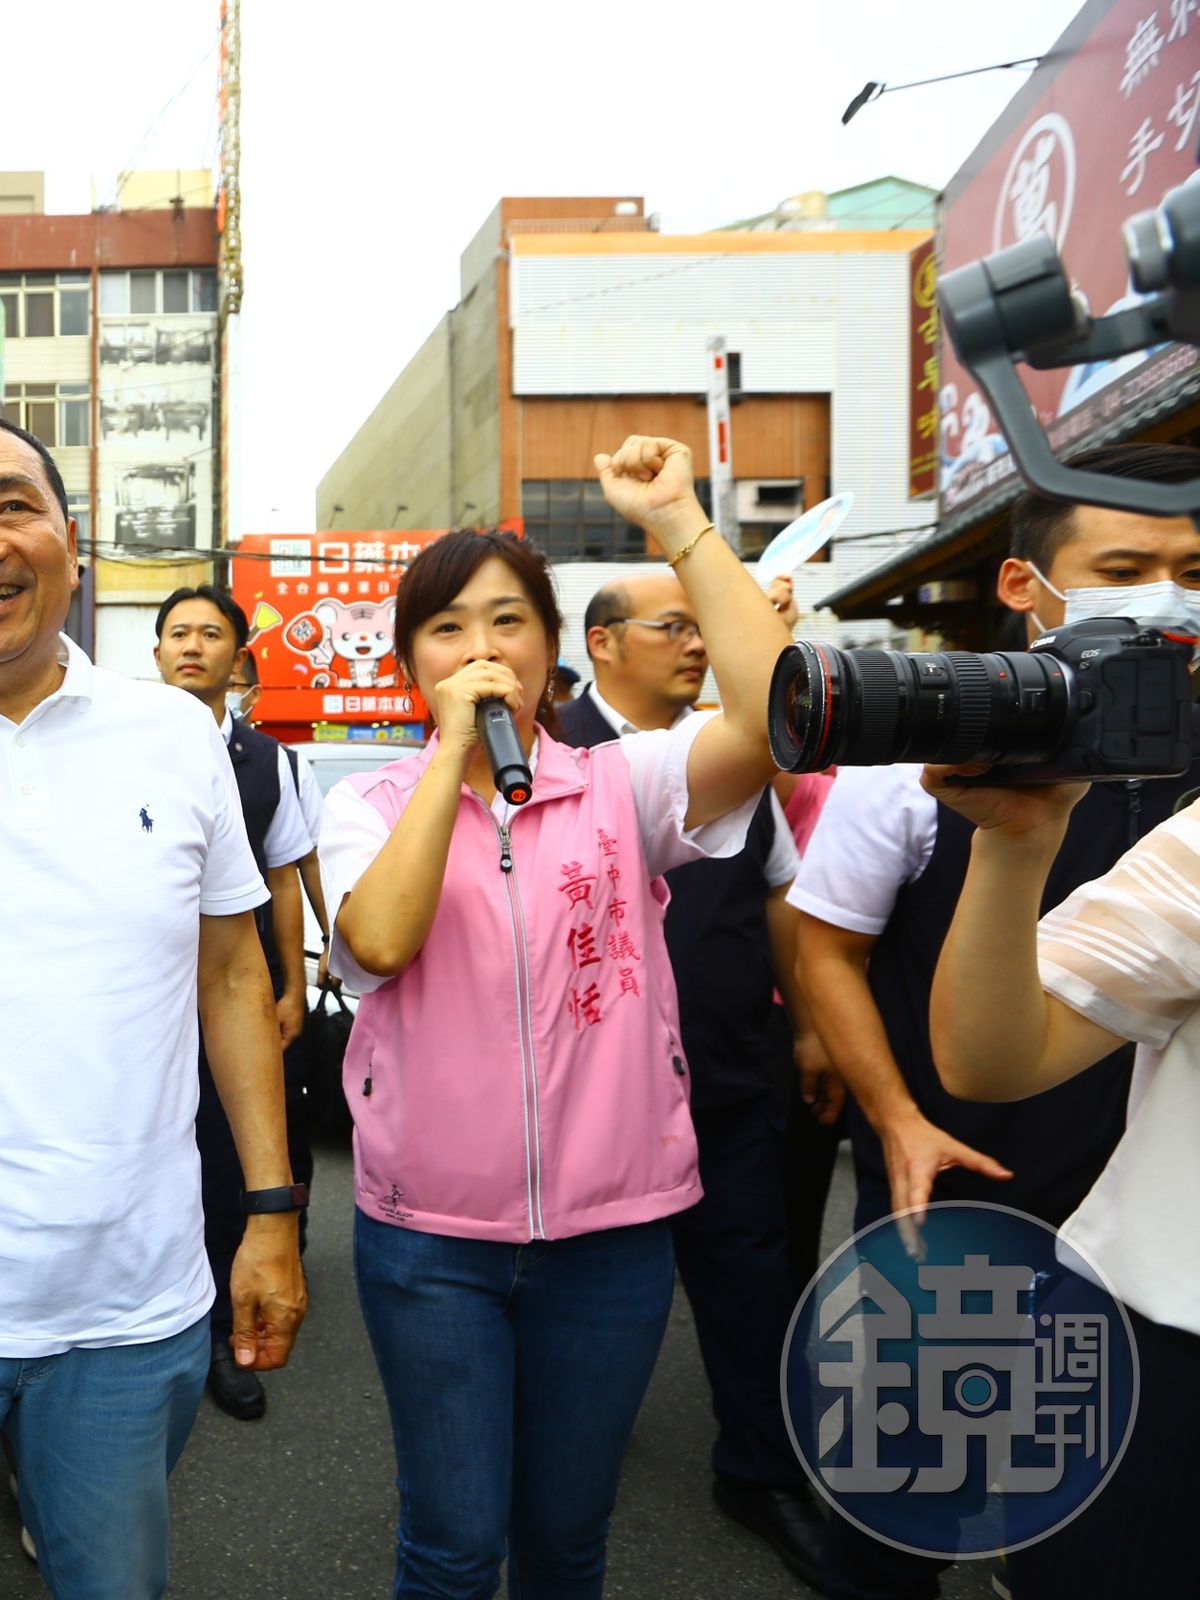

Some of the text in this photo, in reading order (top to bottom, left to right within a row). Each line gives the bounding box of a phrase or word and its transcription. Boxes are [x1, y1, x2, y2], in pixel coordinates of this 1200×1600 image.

[318, 540, 431, 575] 日藥本
[1081, 648, 1102, 659] EOS
[558, 861, 602, 1030] 黃佳恬
[596, 828, 641, 998] 臺中市議員
